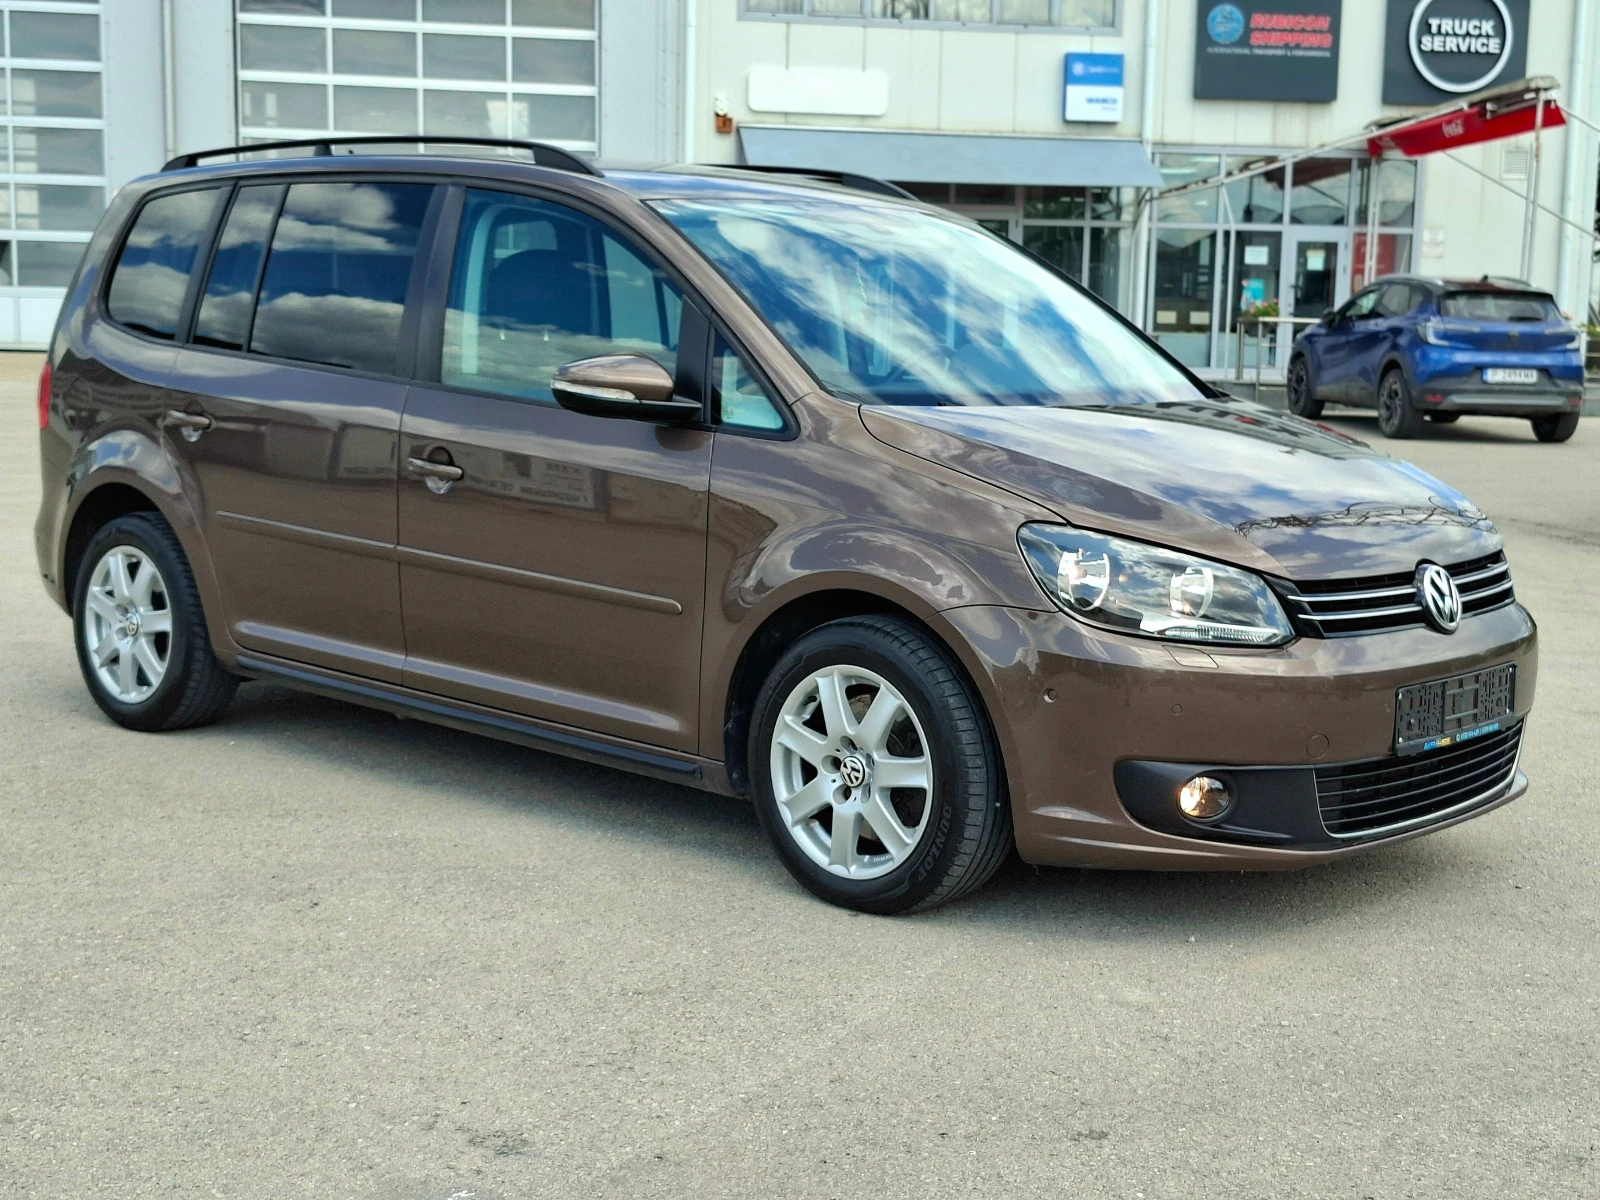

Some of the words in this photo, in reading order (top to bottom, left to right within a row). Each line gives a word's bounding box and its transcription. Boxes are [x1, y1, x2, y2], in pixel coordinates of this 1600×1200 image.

[1249, 13, 1331, 31] RUBICON
[1427, 17, 1496, 36] TRUCK
[1249, 30, 1333, 48] SHIPPING
[1420, 34, 1501, 54] SERVICE
[918, 804, 952, 882] DUNLOP
